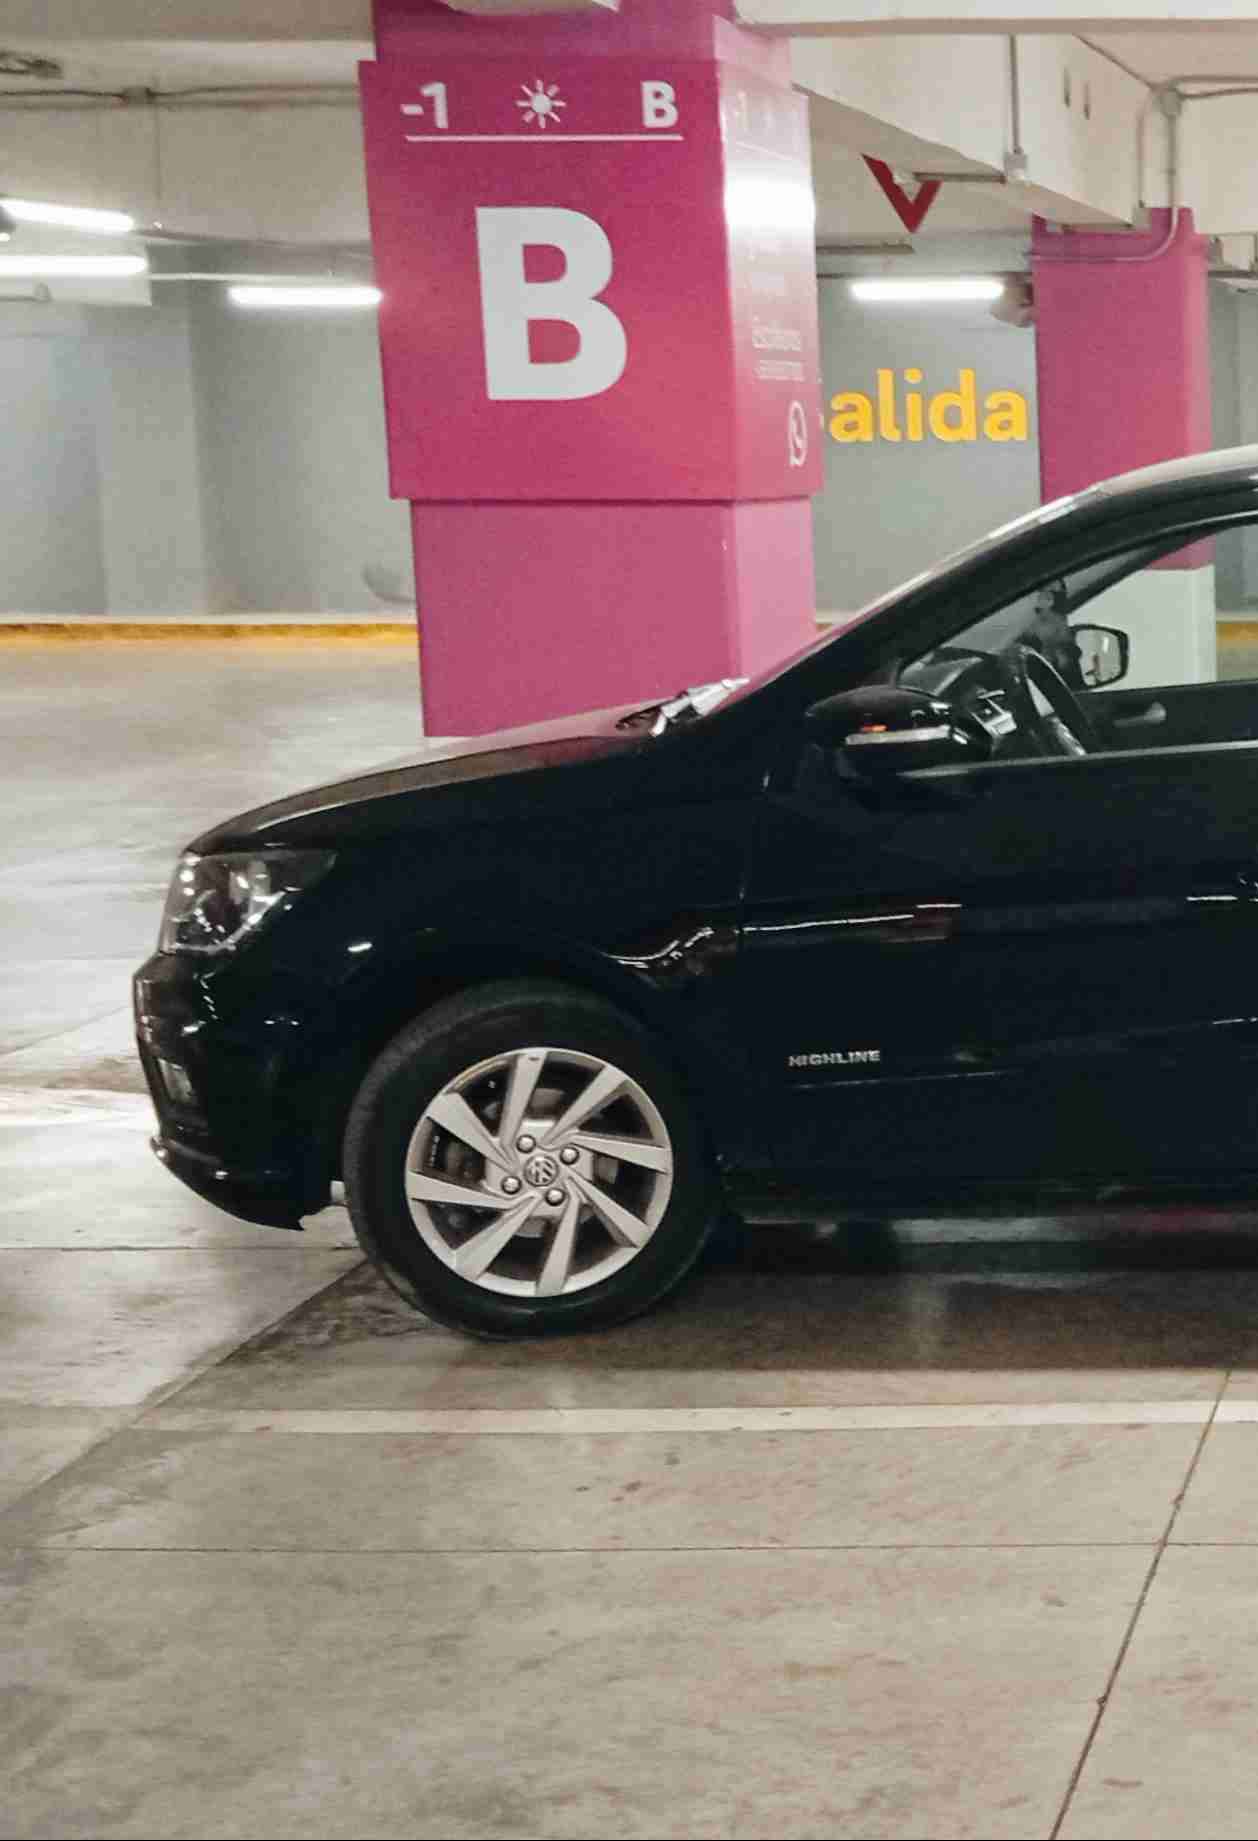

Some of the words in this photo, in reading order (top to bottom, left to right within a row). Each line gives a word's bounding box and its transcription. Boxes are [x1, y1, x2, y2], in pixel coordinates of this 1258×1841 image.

[400, 81, 449, 129] -1
[641, 81, 679, 129] B
[475, 206, 628, 401] B
[820, 367, 1028, 442] alida
[788, 1050, 881, 1067] HIGHLINE
